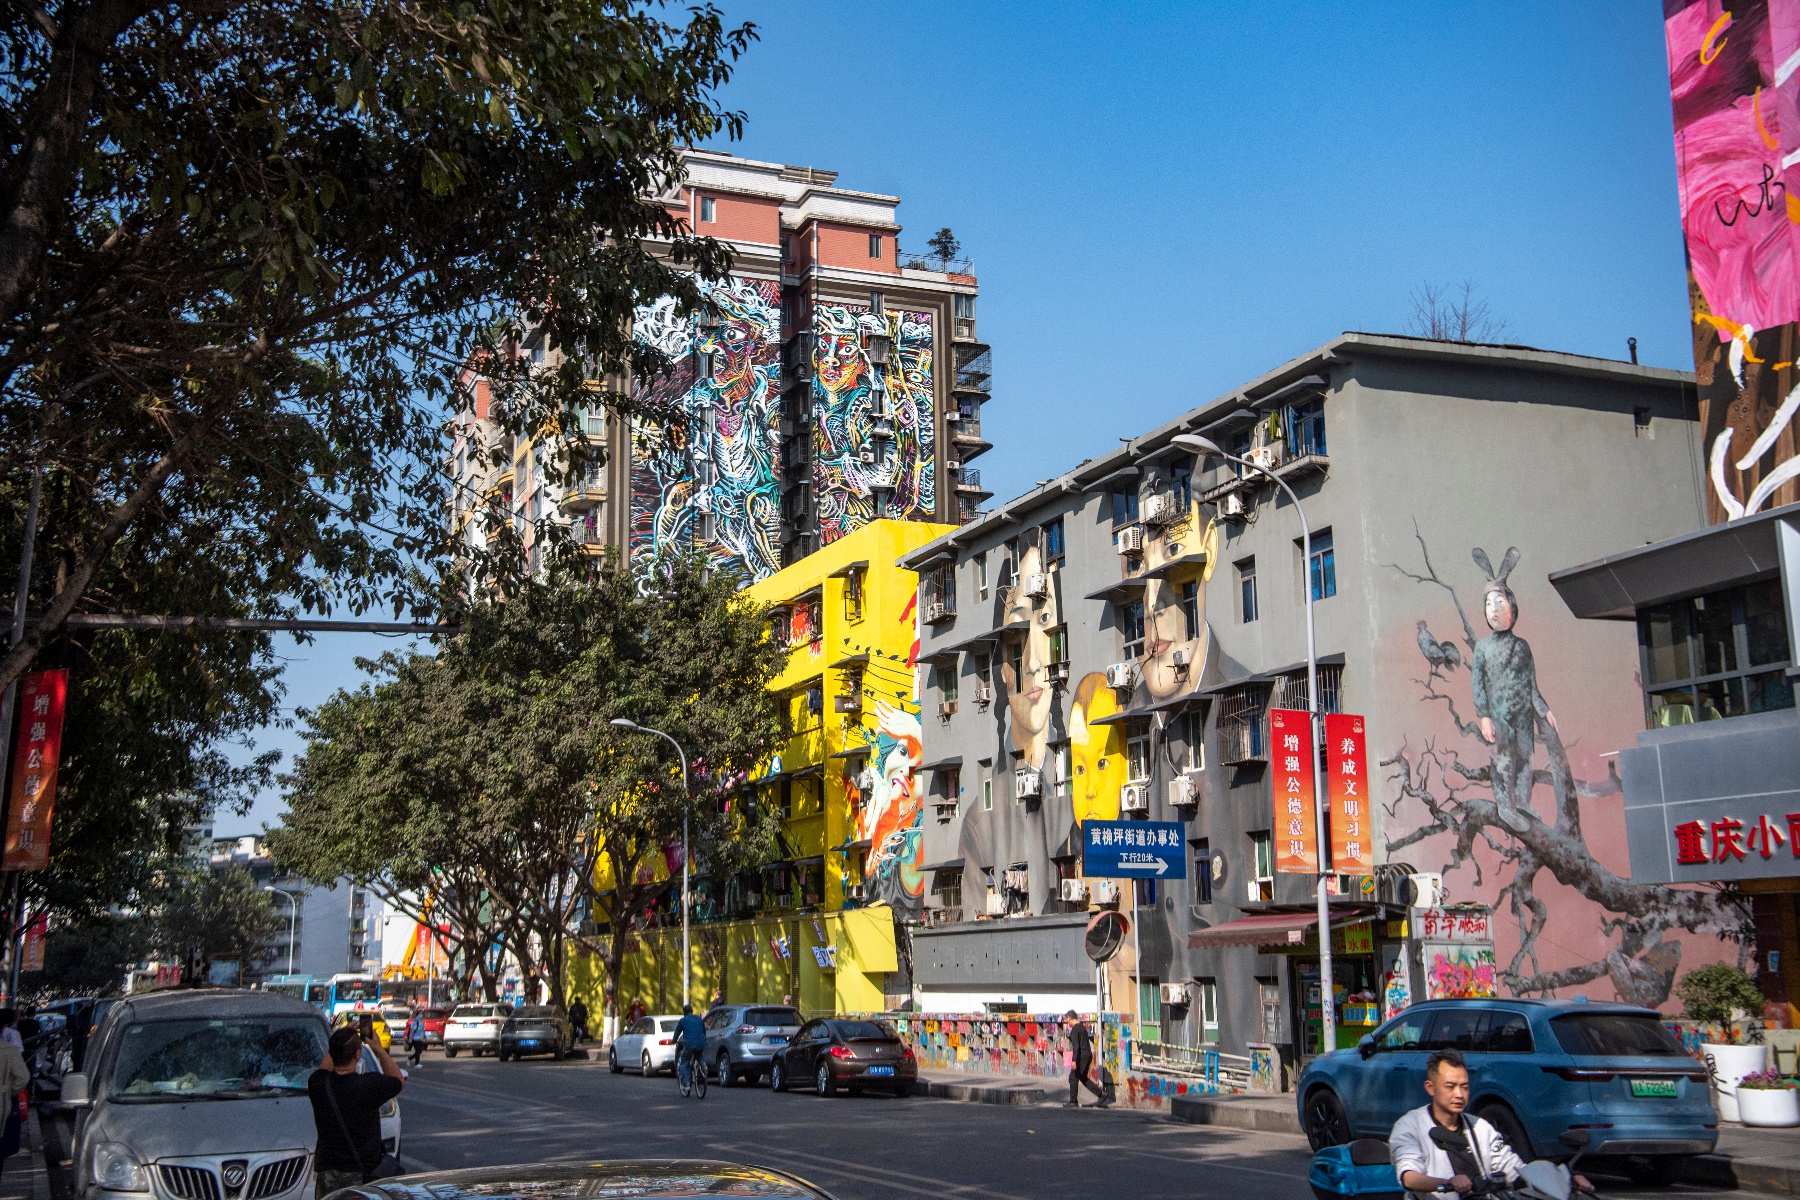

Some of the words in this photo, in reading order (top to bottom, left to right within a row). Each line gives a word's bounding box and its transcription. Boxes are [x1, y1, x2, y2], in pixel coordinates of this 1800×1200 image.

[18, 694, 50, 850] 增强公德意识
[1283, 734, 1305, 857] 增强公德意识
[1341, 738, 1361, 858] 养成文明习惯
[1091, 828, 1179, 846] 黄桷坪街道办事处
[1120, 853, 1154, 862] 下行20米
[1423, 908, 1488, 940] 留学顺利
[1348, 940, 1370, 951] 水果
